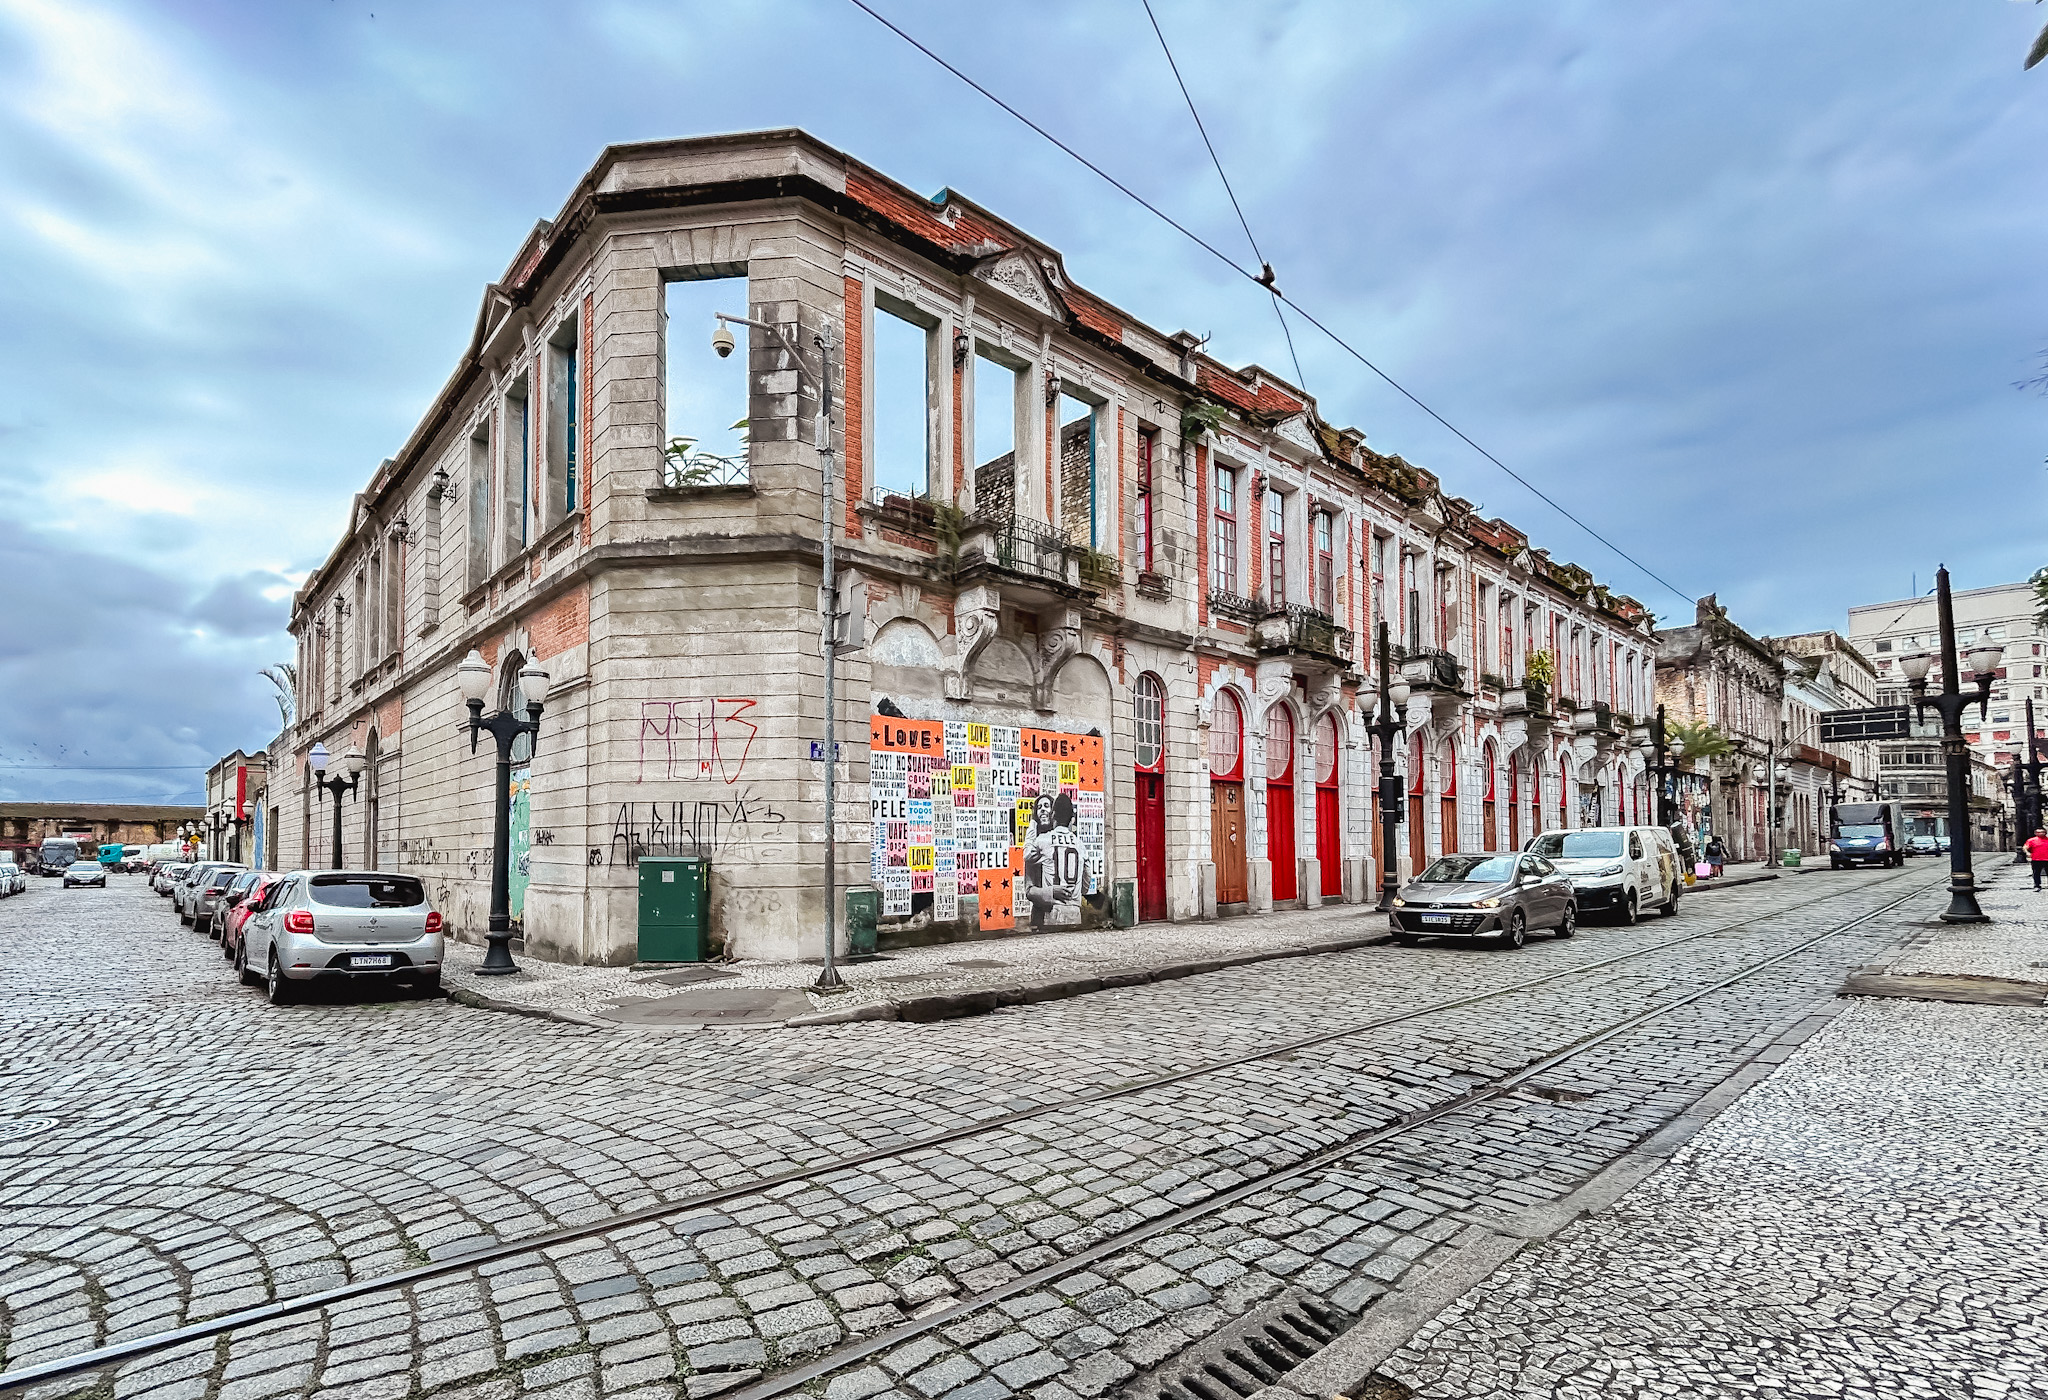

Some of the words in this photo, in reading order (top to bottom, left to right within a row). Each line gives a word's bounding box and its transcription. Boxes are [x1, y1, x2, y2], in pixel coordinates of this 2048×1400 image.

[884, 725, 931, 749] LOVE
[970, 725, 988, 743] LOVE
[1032, 734, 1068, 756] LOVE
[896, 755, 906, 771] NO
[907, 755, 931, 773] SUAVE
[946, 750, 967, 764] FIGHT
[969, 750, 990, 765] ANSWER
[954, 768, 972, 785] LOVE
[1060, 764, 1075, 780] LOVE
[931, 779, 952, 796] VIDA
[1018, 801, 1034, 810] JUS
[889, 823, 907, 840] UAVE
[887, 842, 906, 852] OISA
[912, 848, 931, 866] LOVE
[956, 853, 978, 870] SUAVE
[1052, 846, 1079, 884] 10
[1092, 856, 1103, 875] LÉ
